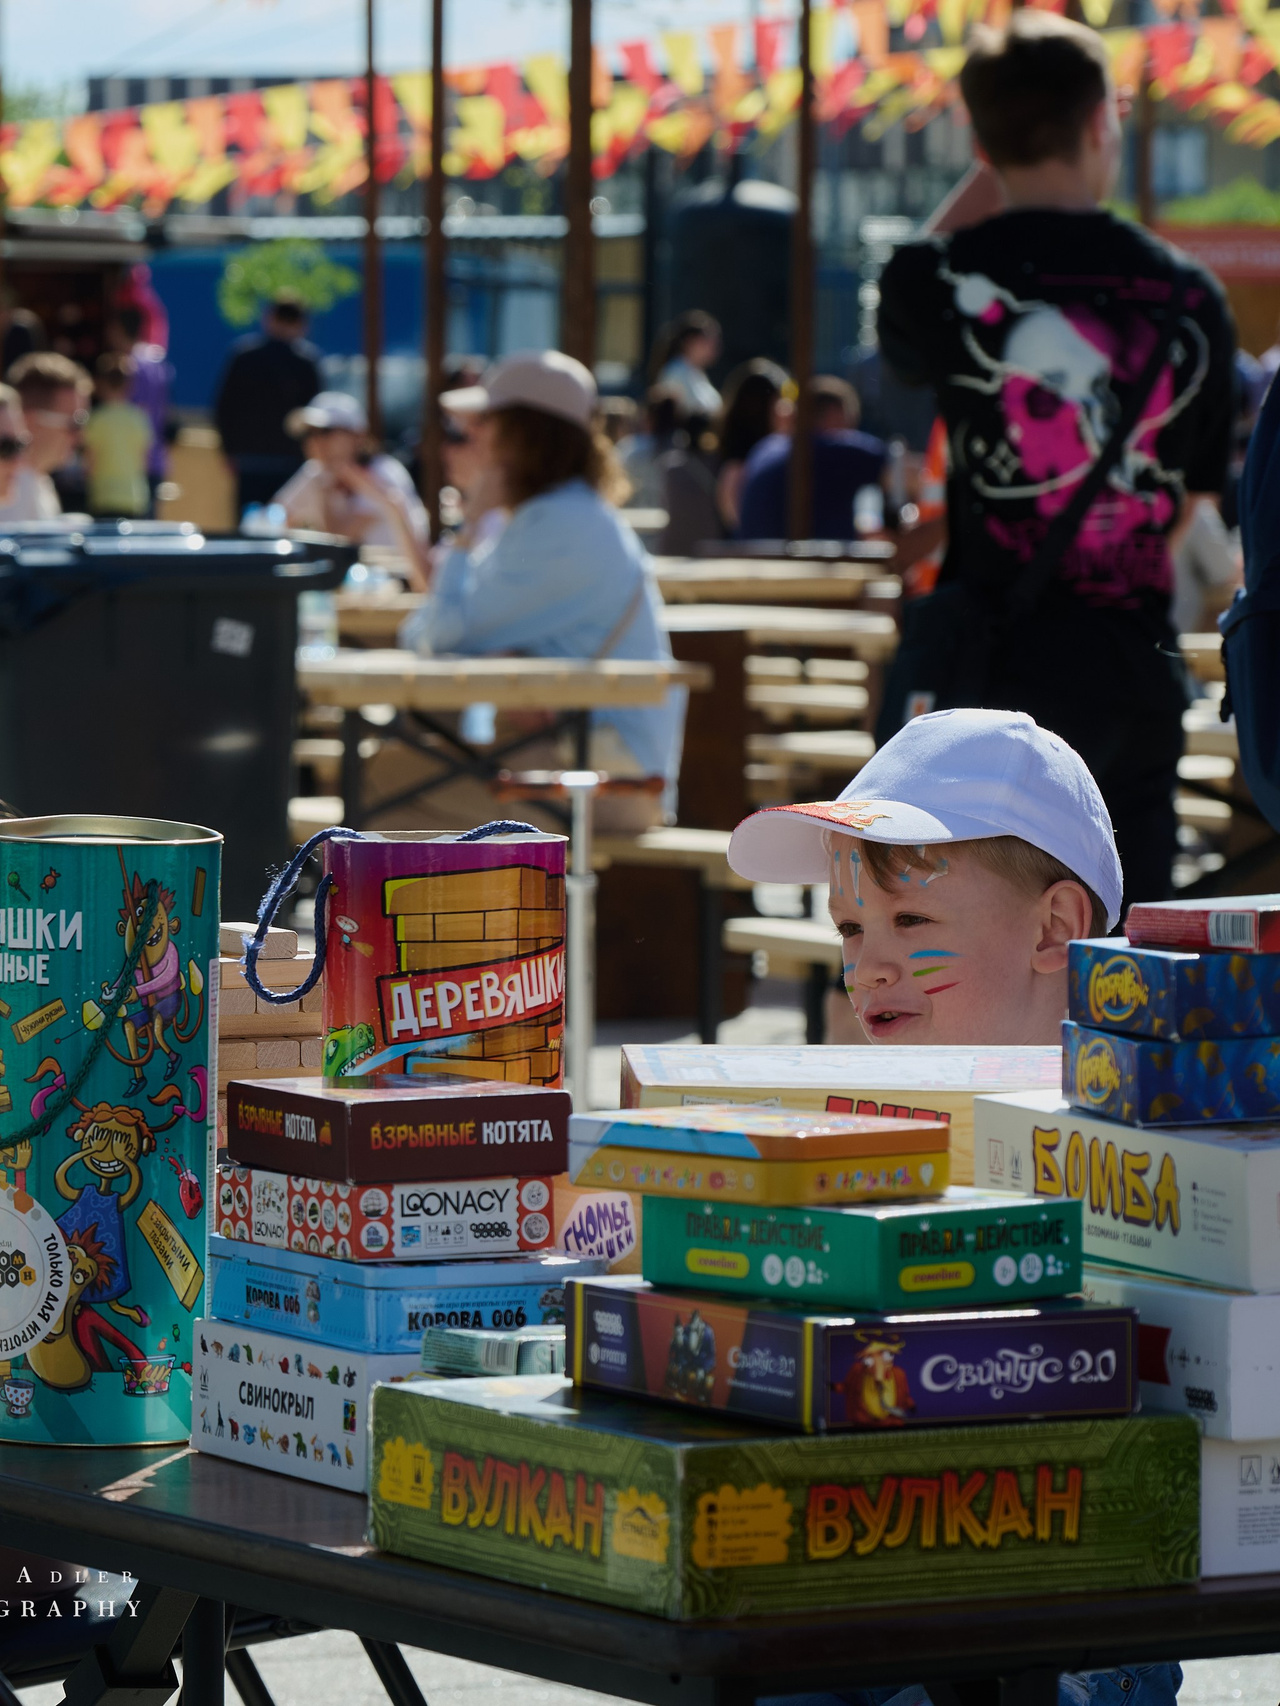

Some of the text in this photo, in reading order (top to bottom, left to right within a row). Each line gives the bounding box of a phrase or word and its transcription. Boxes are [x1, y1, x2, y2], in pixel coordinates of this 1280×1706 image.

[389, 951, 565, 1039] ДЕРЕВЯШКИ
[284, 1112, 317, 1143] КОТЯТА
[371, 1119, 553, 1150] ВЗРЫВНЫЕ КОТЯТА
[1033, 1126, 1181, 1236] БОМБА
[401, 1188, 510, 1218] LOONACY
[564, 1200, 631, 1252] ГНОМЫ
[43, 1233, 64, 1288] ТОЛЬКО
[37, 1291, 59, 1323] ДЛЯ
[246, 1284, 281, 1311] КОРОВА
[283, 1294, 301, 1315] 006
[408, 1306, 527, 1332] КОРОВА 006
[238, 1380, 315, 1421] СВИНОКРЫЛ
[441, 1449, 606, 1558] ВУЛКАН
[805, 1465, 1083, 1561] ВУЛКАН
